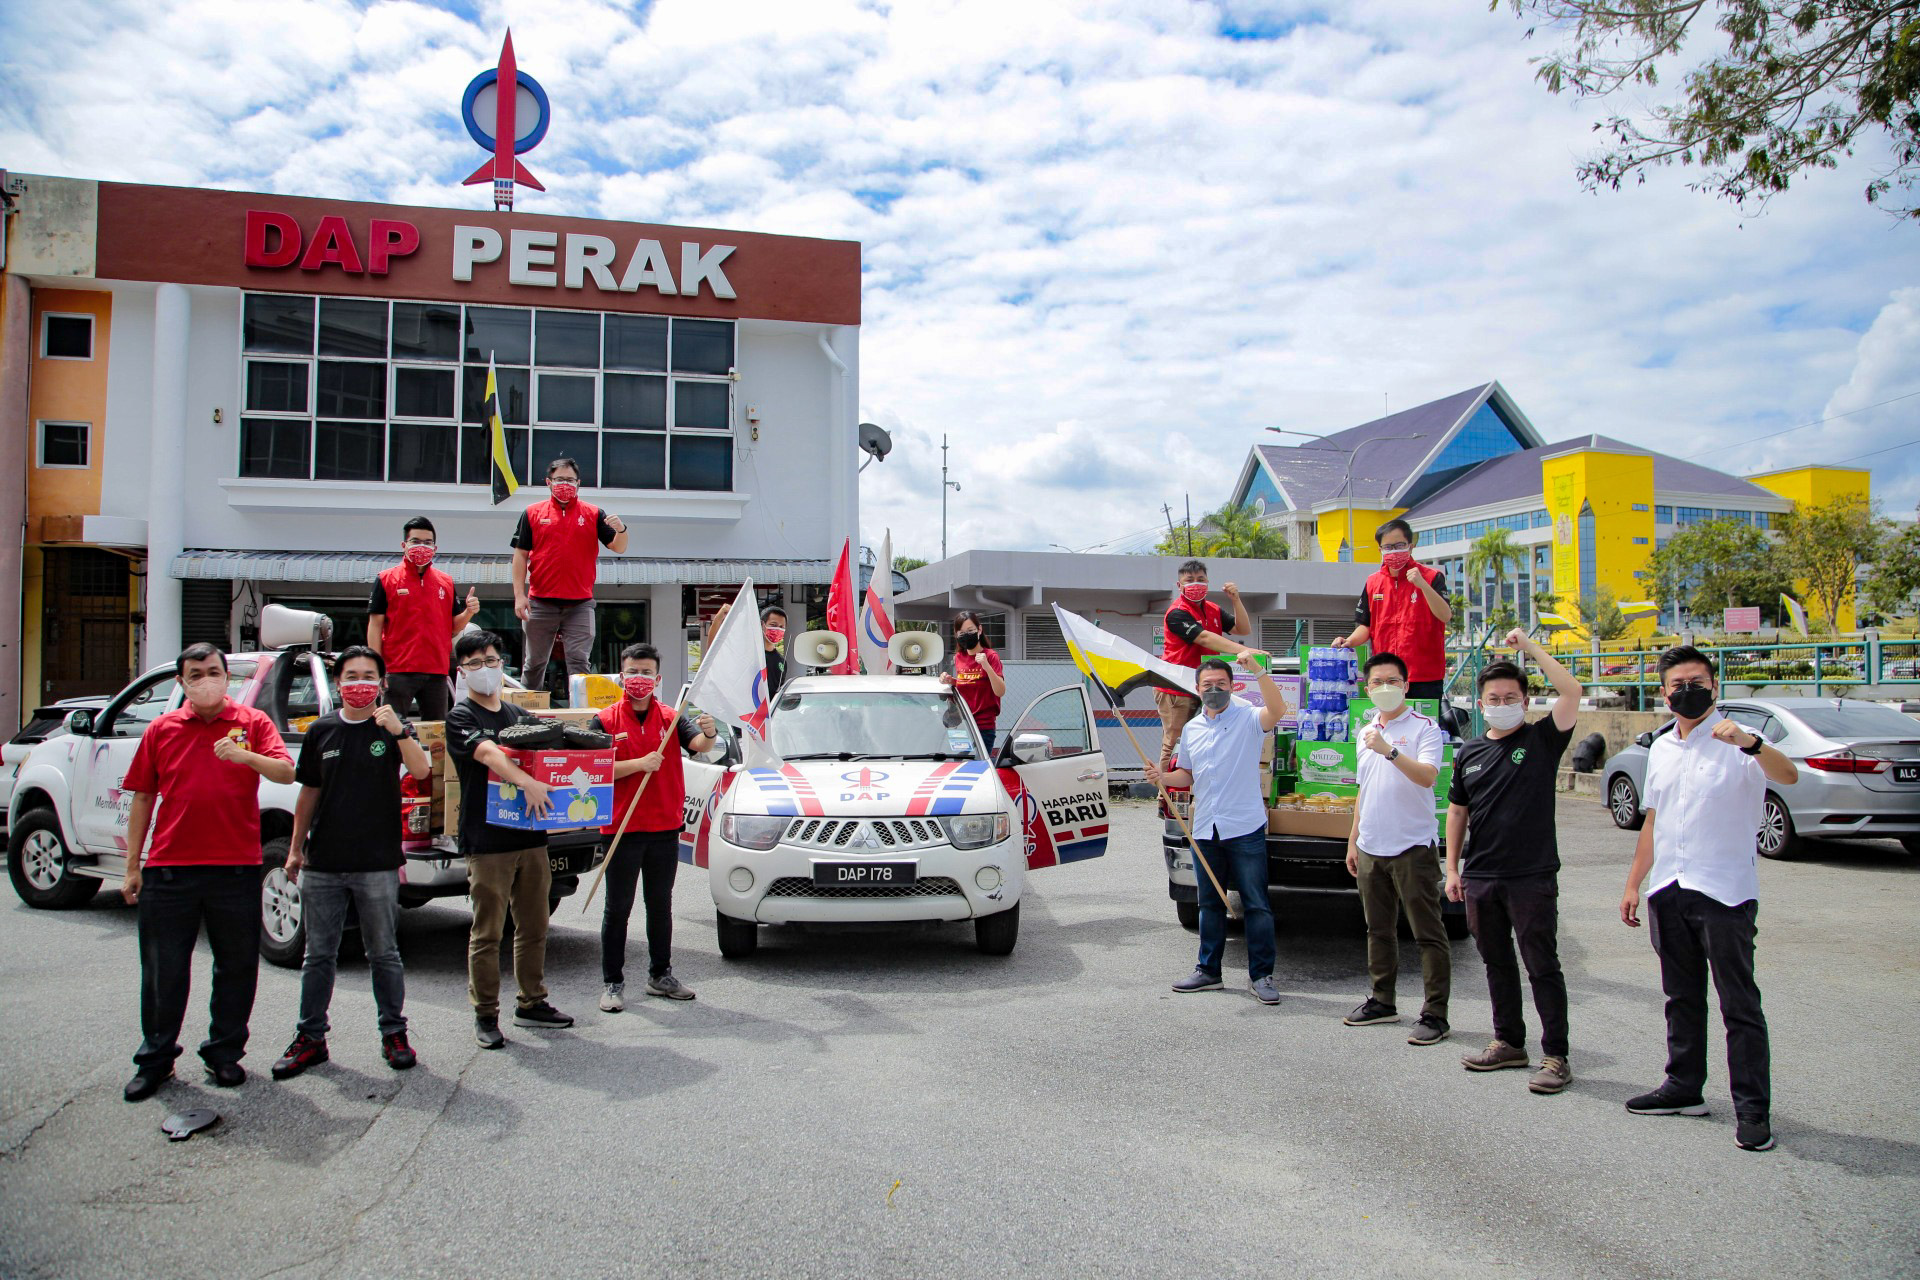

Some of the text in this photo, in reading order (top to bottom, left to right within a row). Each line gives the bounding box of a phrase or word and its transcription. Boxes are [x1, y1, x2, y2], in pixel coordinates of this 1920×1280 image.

[244, 209, 738, 300] DAP PERAK
[549, 771, 573, 783] Fres
[1900, 769, 1917, 778] ALC
[840, 792, 890, 801] DAP
[1041, 791, 1103, 810] HARAPAN
[1046, 802, 1108, 826] BARU
[550, 856, 569, 872] 951
[838, 867, 893, 881] DAP 178
